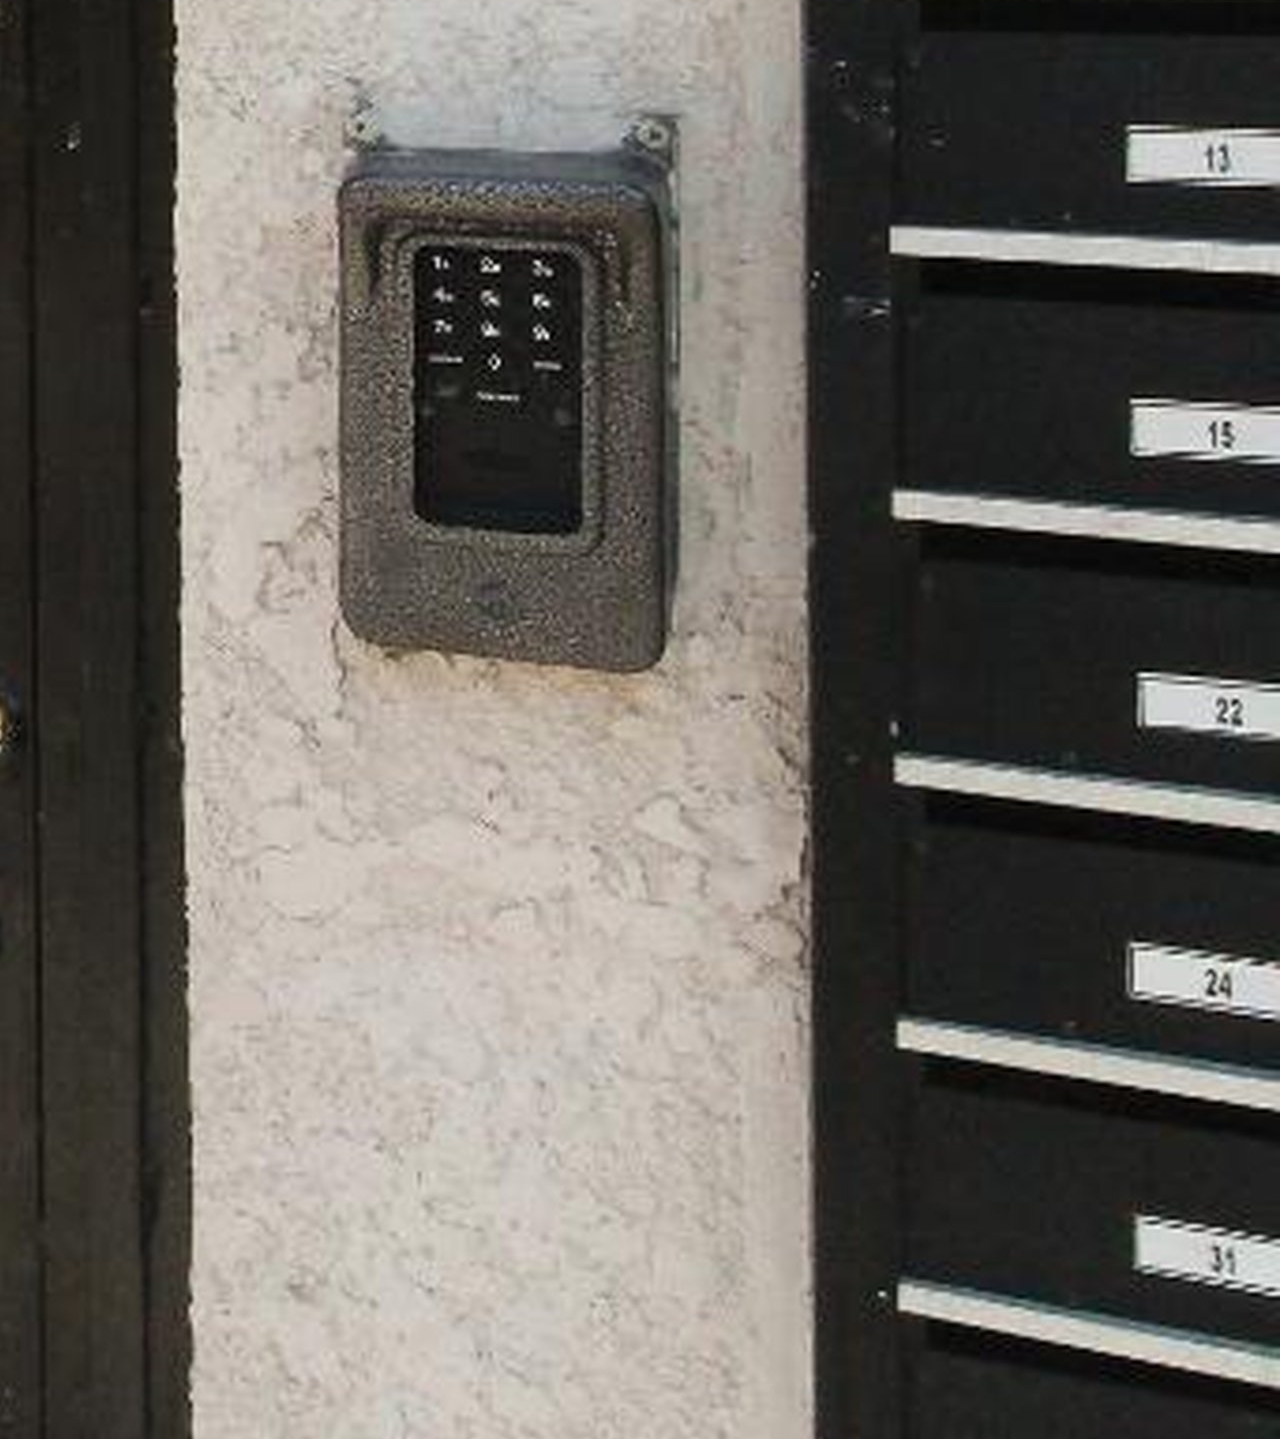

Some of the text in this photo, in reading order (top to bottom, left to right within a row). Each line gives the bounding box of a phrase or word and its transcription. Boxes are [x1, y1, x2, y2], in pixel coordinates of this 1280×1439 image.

[1205, 144, 1231, 173] 13
[1209, 421, 1236, 449] 15
[1216, 697, 1243, 726] 22
[1205, 968, 1233, 998] 24
